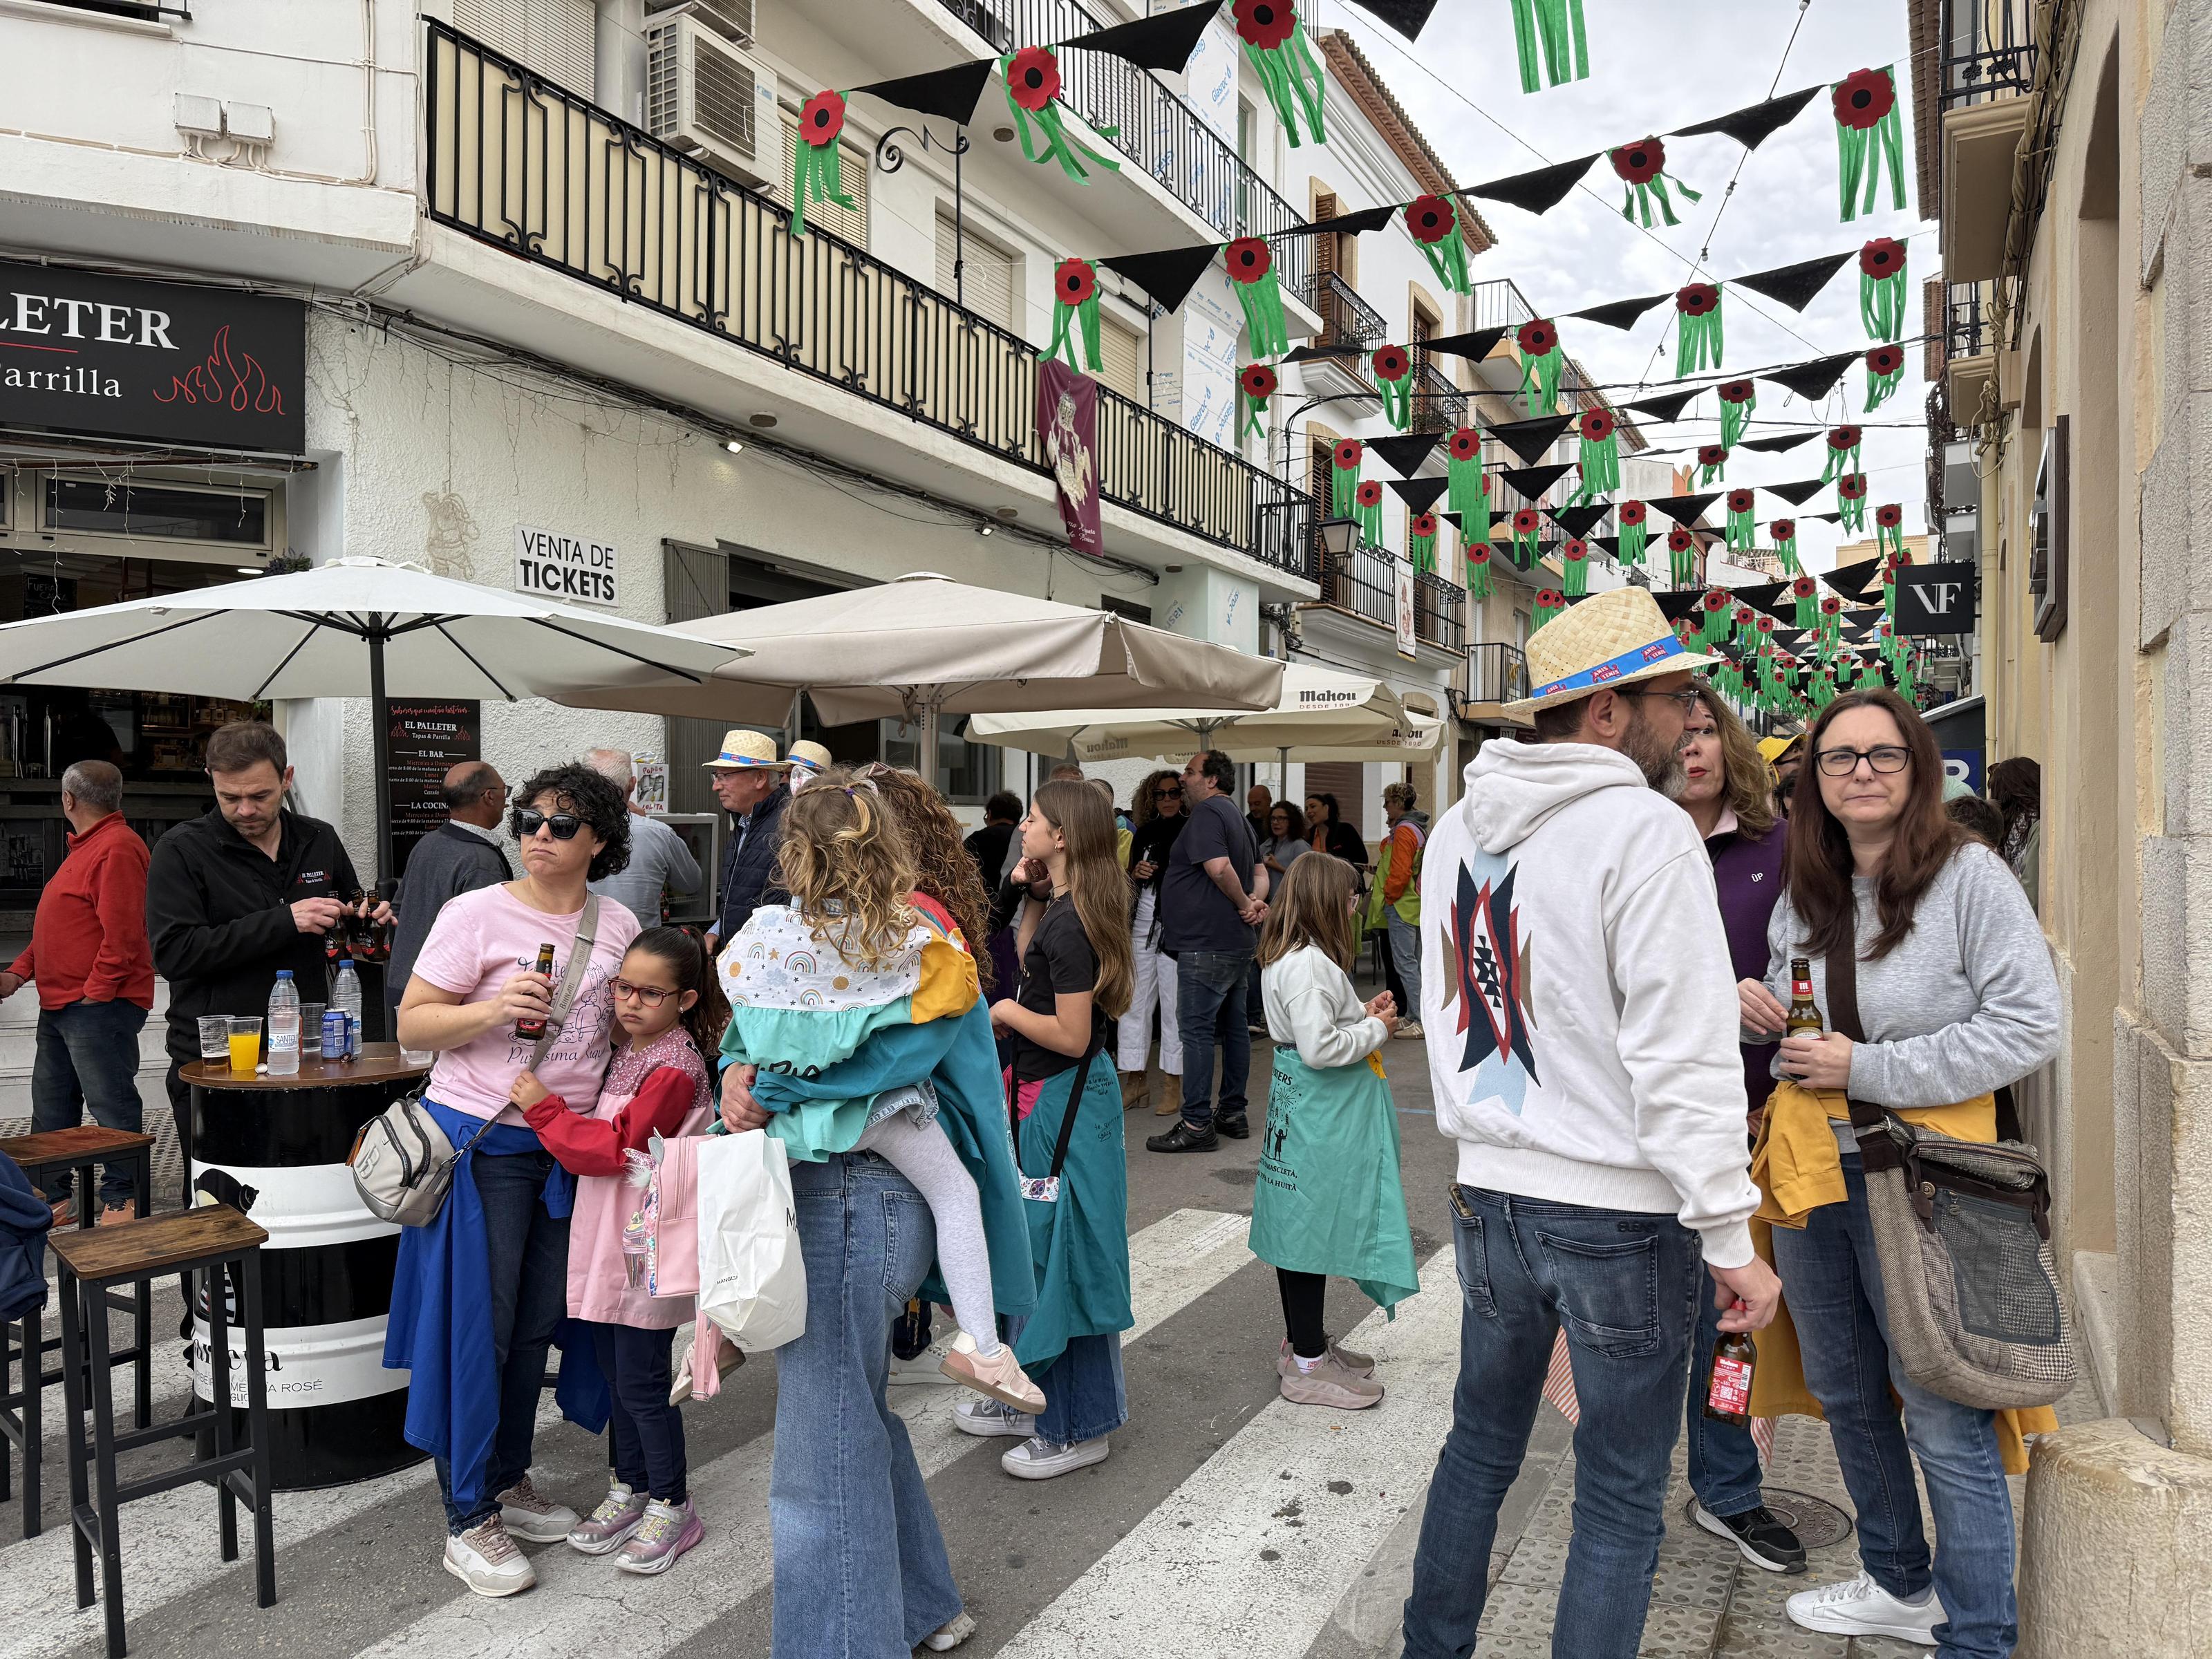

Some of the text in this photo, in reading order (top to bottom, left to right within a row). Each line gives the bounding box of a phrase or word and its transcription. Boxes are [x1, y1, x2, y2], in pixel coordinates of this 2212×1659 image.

[0, 292, 180, 350] ETER
[0, 362, 123, 398] arrilla
[521, 529, 614, 570] VENTA DE
[520, 559, 615, 601] TICKETS
[1908, 582, 1962, 615] VF
[1300, 690, 1356, 702] Mahou
[404, 721, 457, 731] EL PALLETER
[281, 1378, 323, 1393] ROSÉ
